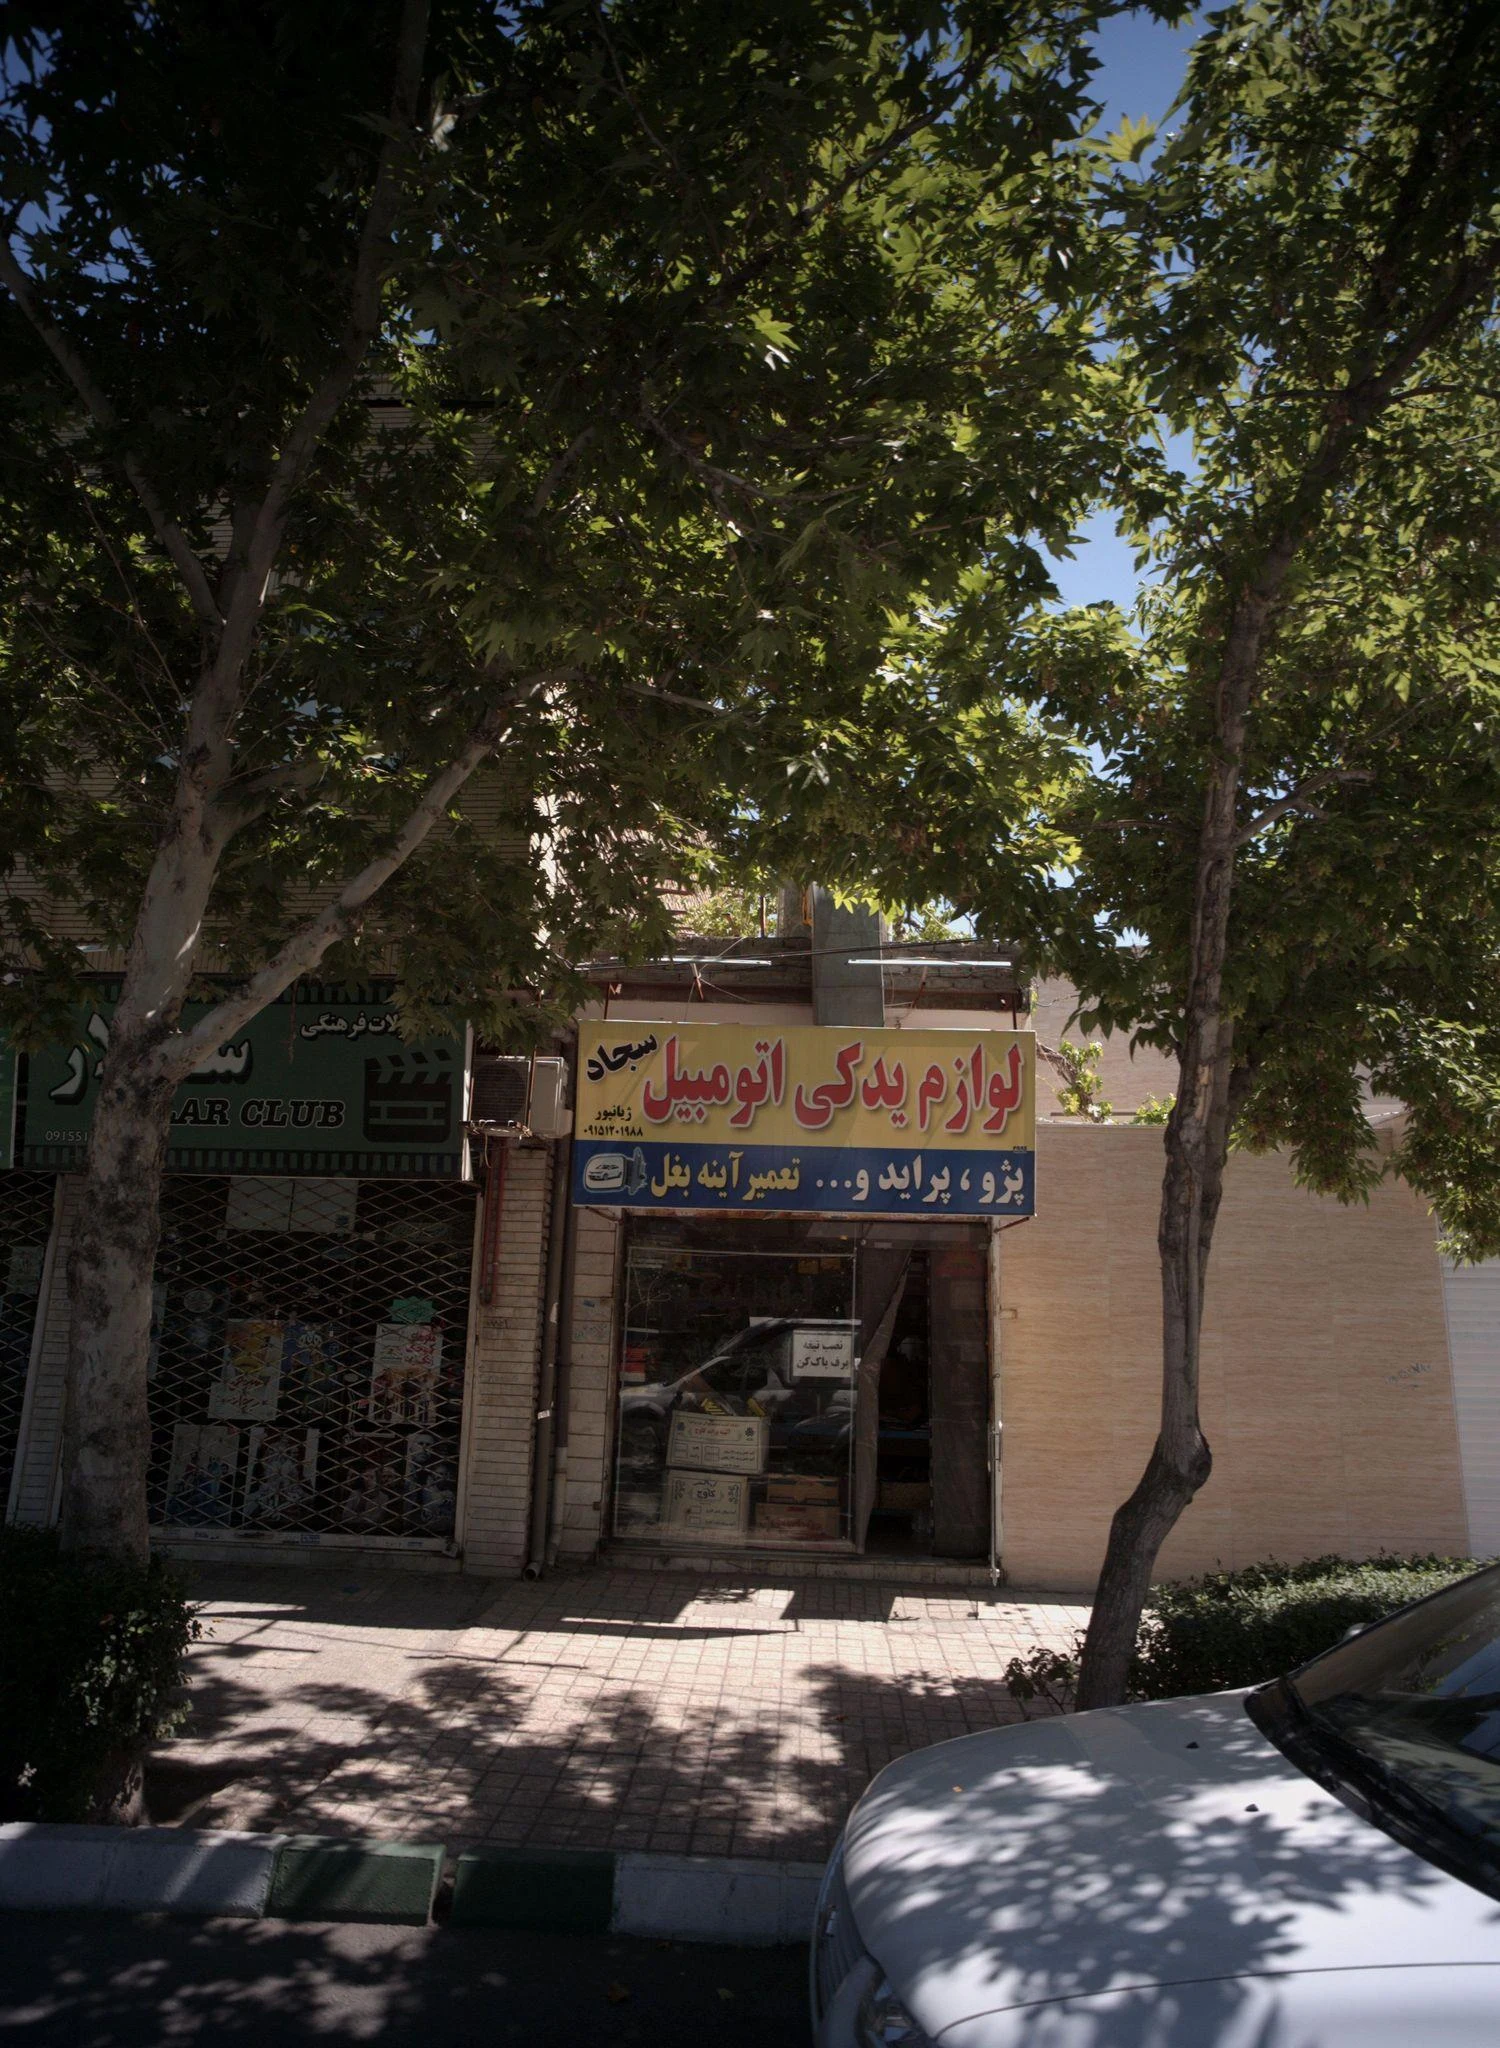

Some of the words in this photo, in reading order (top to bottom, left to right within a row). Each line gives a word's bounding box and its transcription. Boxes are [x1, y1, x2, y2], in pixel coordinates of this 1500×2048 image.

[300, 1010, 367, 1039] فرهنگی
[586, 1033, 659, 1081] سجاد
[643, 1036, 785, 1127] اتومبیل
[794, 1040, 906, 1128] یدکی
[918, 1042, 1023, 1131] لوازم
[45, 1130, 88, 1142] 091551
[240, 1098, 346, 1129] CLUB
[650, 1151, 691, 1197] بغل
[697, 1150, 744, 1199] آینه
[742, 1157, 800, 1201] تعمیر
[878, 1154, 952, 1205] پراید
[978, 1159, 1024, 1206] پژو
